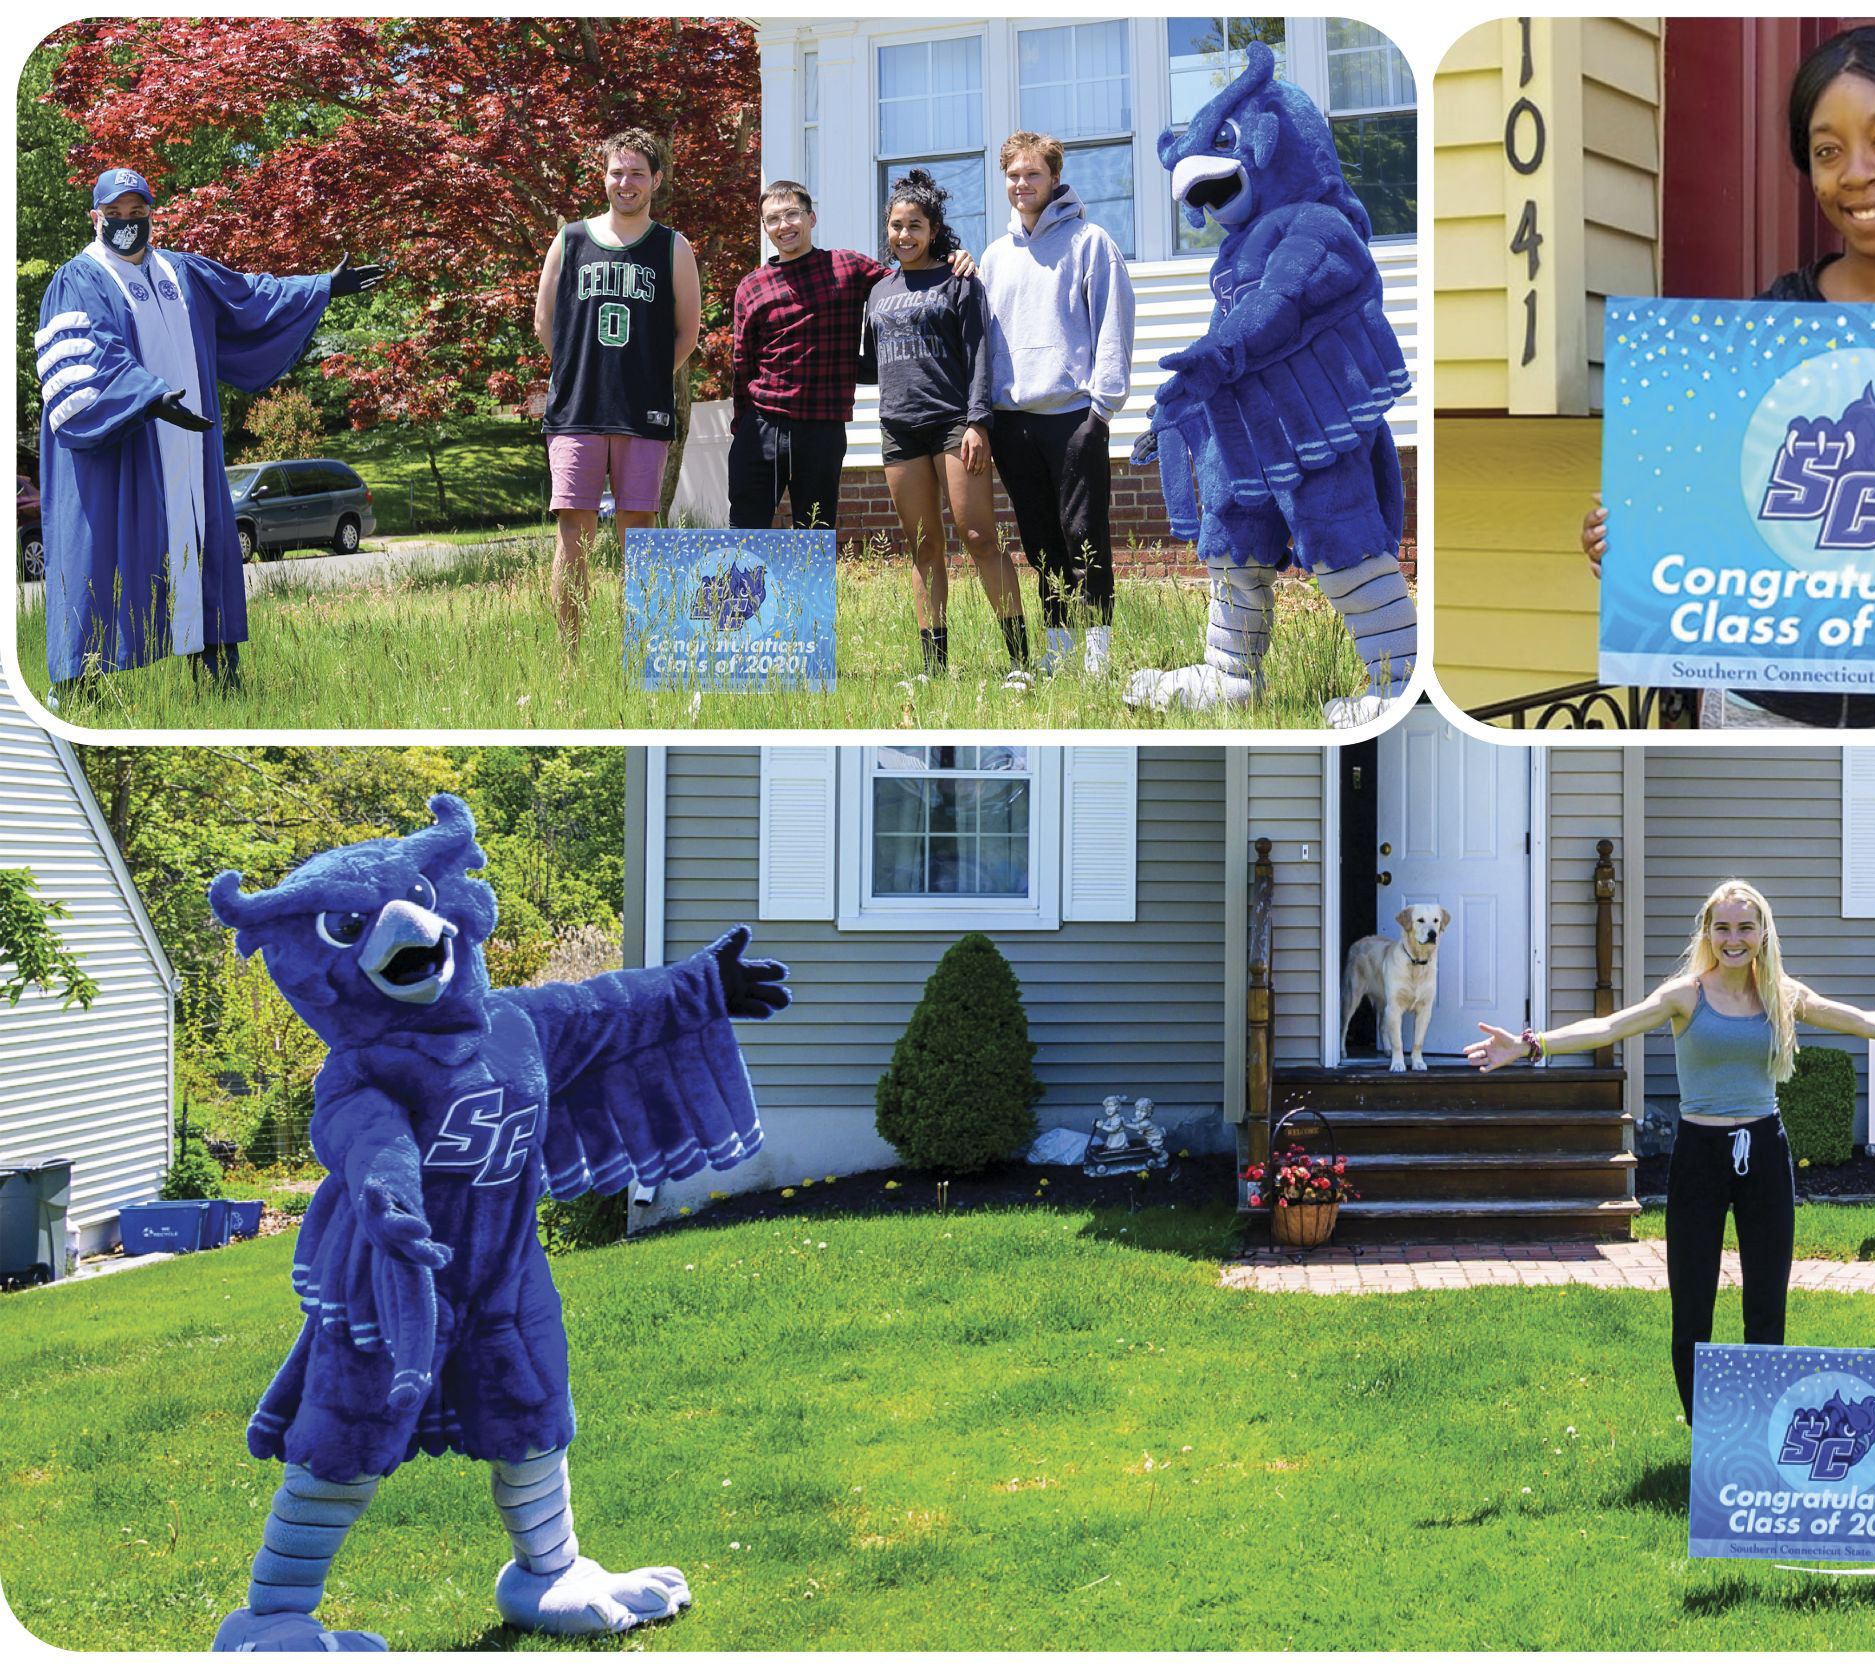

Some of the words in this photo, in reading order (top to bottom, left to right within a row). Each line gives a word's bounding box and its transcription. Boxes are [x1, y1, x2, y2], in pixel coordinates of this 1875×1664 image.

[1505, 17, 1545, 367] 1041
[578, 261, 656, 302] CELTICS
[874, 289, 949, 313] OUTHERN
[598, 302, 631, 347] 0
[879, 335, 948, 365] NNECTICUT
[1669, 602, 1801, 645] Class
[714, 653, 740, 674] of
[744, 655, 808, 674] 2020!
[1671, 662, 1758, 682] Southern
[1763, 664, 1875, 685] Connecticut
[422, 1087, 539, 1186] SC
[1777, 1421, 1856, 1482] SC
[1728, 1510, 1800, 1535] Class
[1810, 1511, 1841, 1536] of
[1729, 1543, 1777, 1554] Southern
[1780, 1545, 1841, 1556] Connecticut
[1845, 1546, 1872, 1557] State
